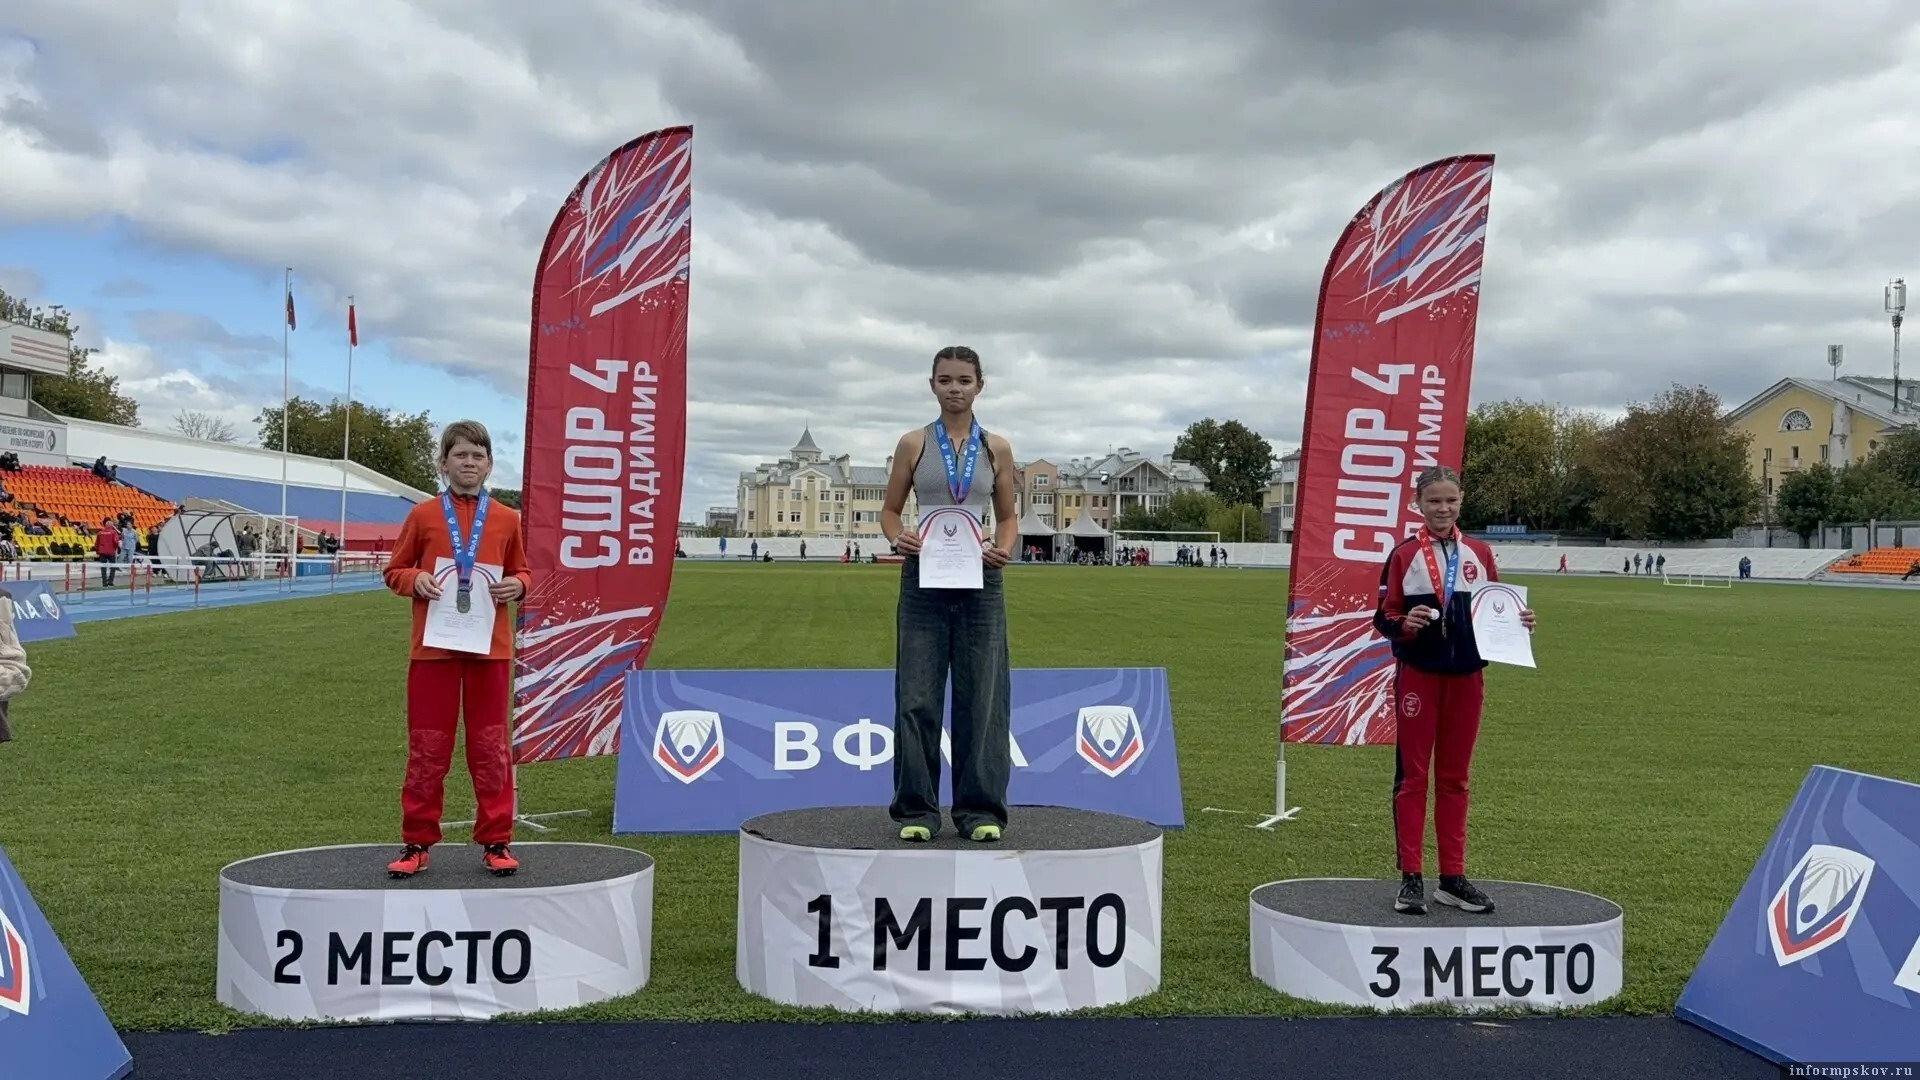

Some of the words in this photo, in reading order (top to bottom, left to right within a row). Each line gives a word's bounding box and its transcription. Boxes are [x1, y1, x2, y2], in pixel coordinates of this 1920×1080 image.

[569, 359, 629, 393] 4
[1351, 363, 1416, 395] 4
[560, 406, 624, 569] СШОР
[628, 361, 661, 565] ВЛАДИМИР
[1333, 408, 1409, 563] СШОР
[274, 929, 303, 984] 2
[327, 929, 531, 986] МЕСТО
[807, 894, 840, 969] 1
[873, 893, 1127, 972] МЕСТО
[1369, 946, 1400, 998] 3
[1424, 943, 1595, 998] МЕСТО
